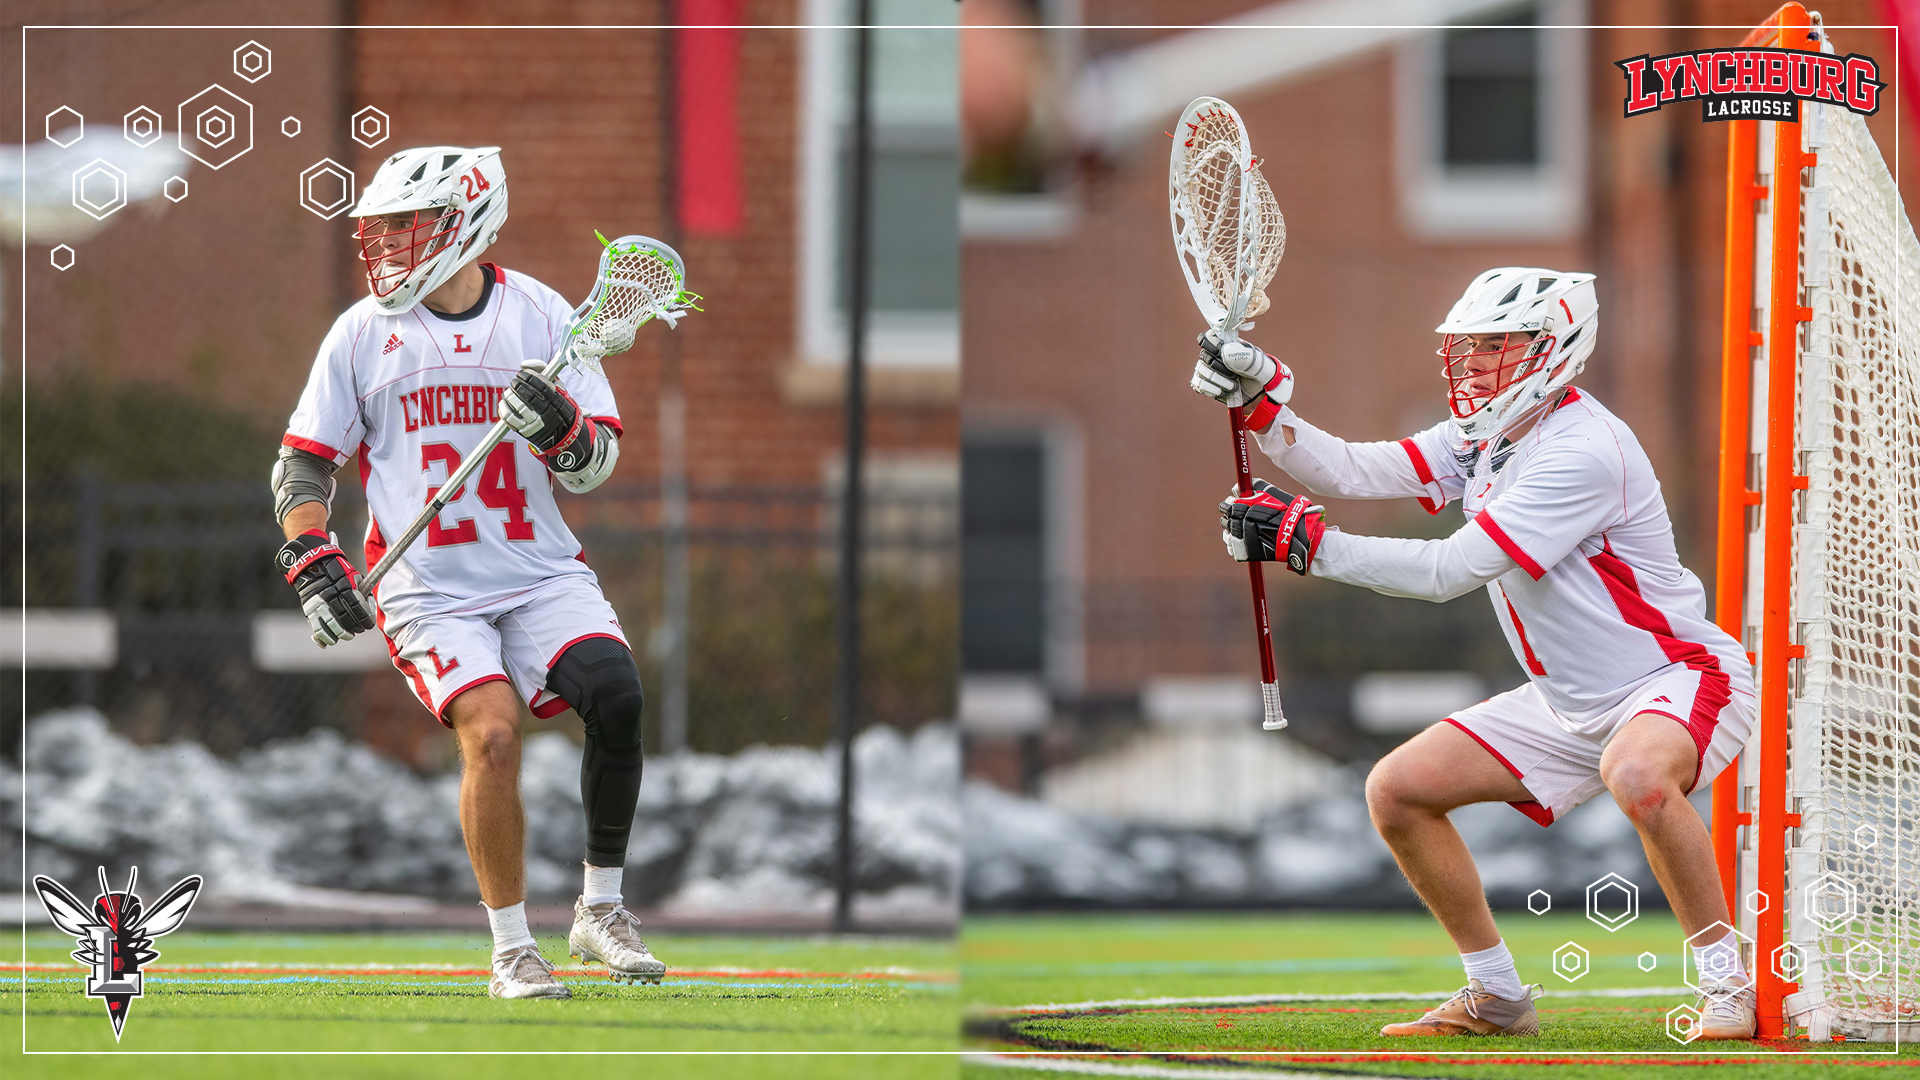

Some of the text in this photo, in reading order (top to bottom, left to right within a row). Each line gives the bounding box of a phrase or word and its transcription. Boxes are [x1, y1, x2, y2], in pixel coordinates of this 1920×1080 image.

[459, 166, 491, 203] 24
[1559, 298, 1575, 325] 1
[453, 333, 473, 354] L
[420, 438, 538, 551] 24
[1280, 495, 1311, 545] VERIK
[424, 644, 462, 683] L
